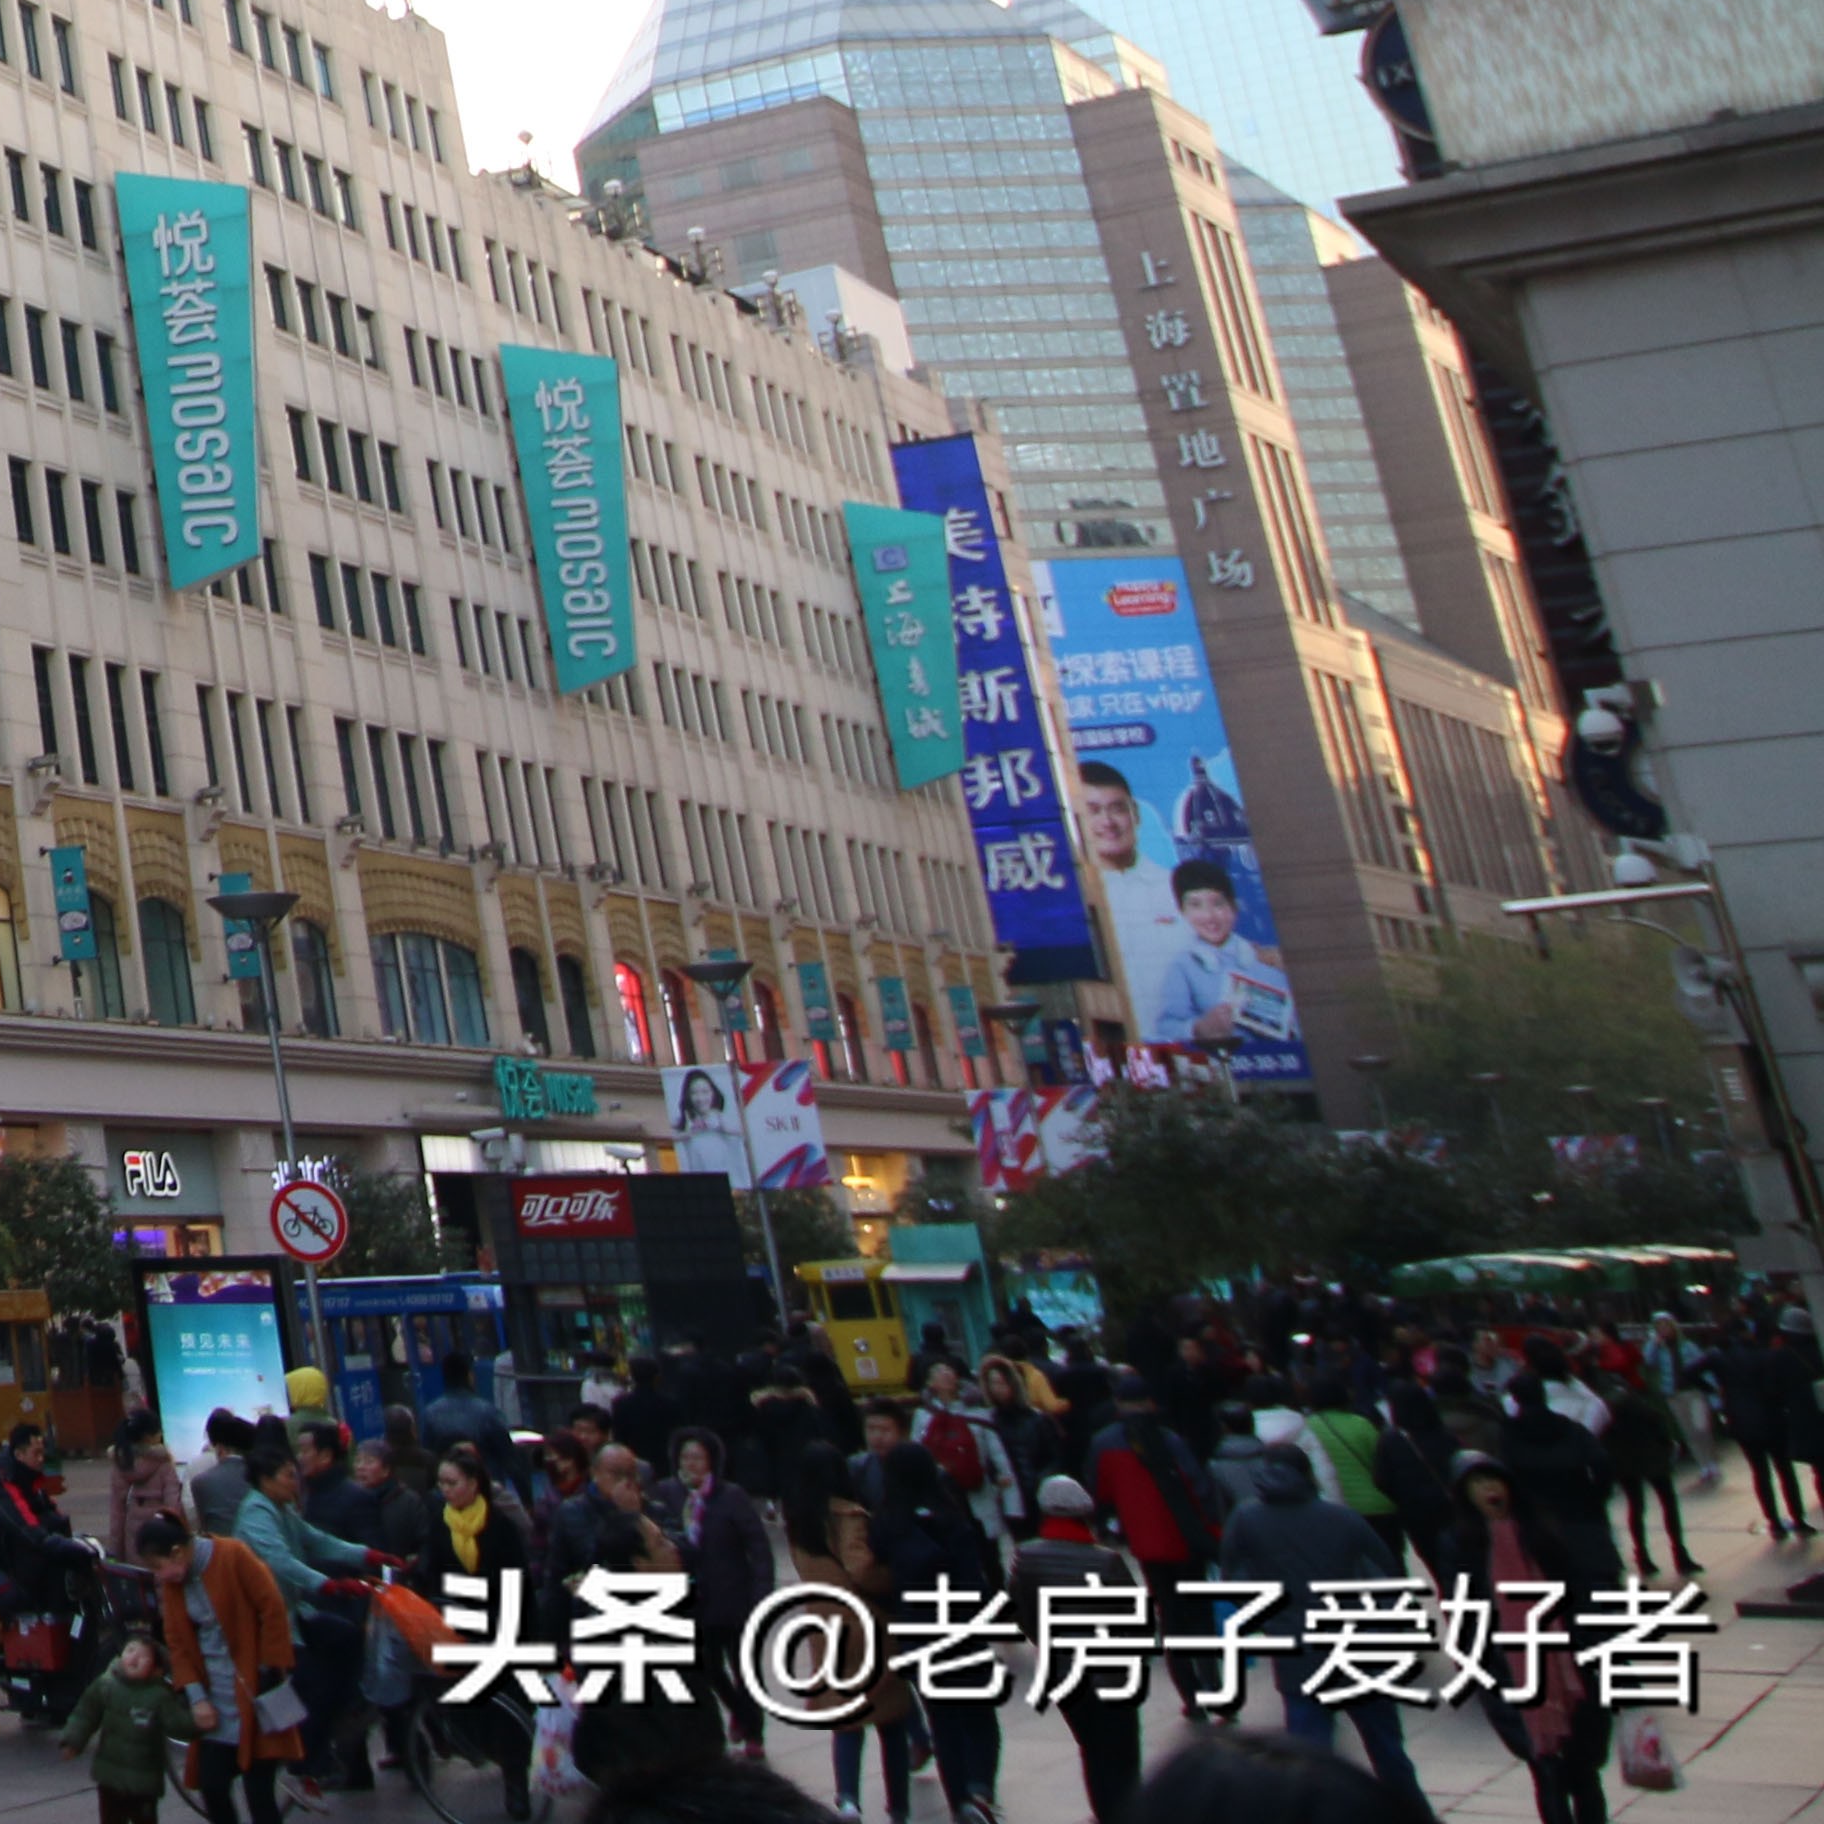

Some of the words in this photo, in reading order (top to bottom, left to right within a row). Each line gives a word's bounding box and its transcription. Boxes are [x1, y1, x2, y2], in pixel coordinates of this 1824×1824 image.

[153, 209, 218, 346] 悦荟
[167, 351, 240, 548] mosaic
[535, 377, 595, 490] 悦荟
[1139, 250, 1255, 588] 上海置地广场
[551, 497, 617, 659] mosaic
[1054, 645, 1199, 687] 探索课程
[123, 1150, 181, 1197] FILA
[520, 1189, 622, 1227] 可口可乐
